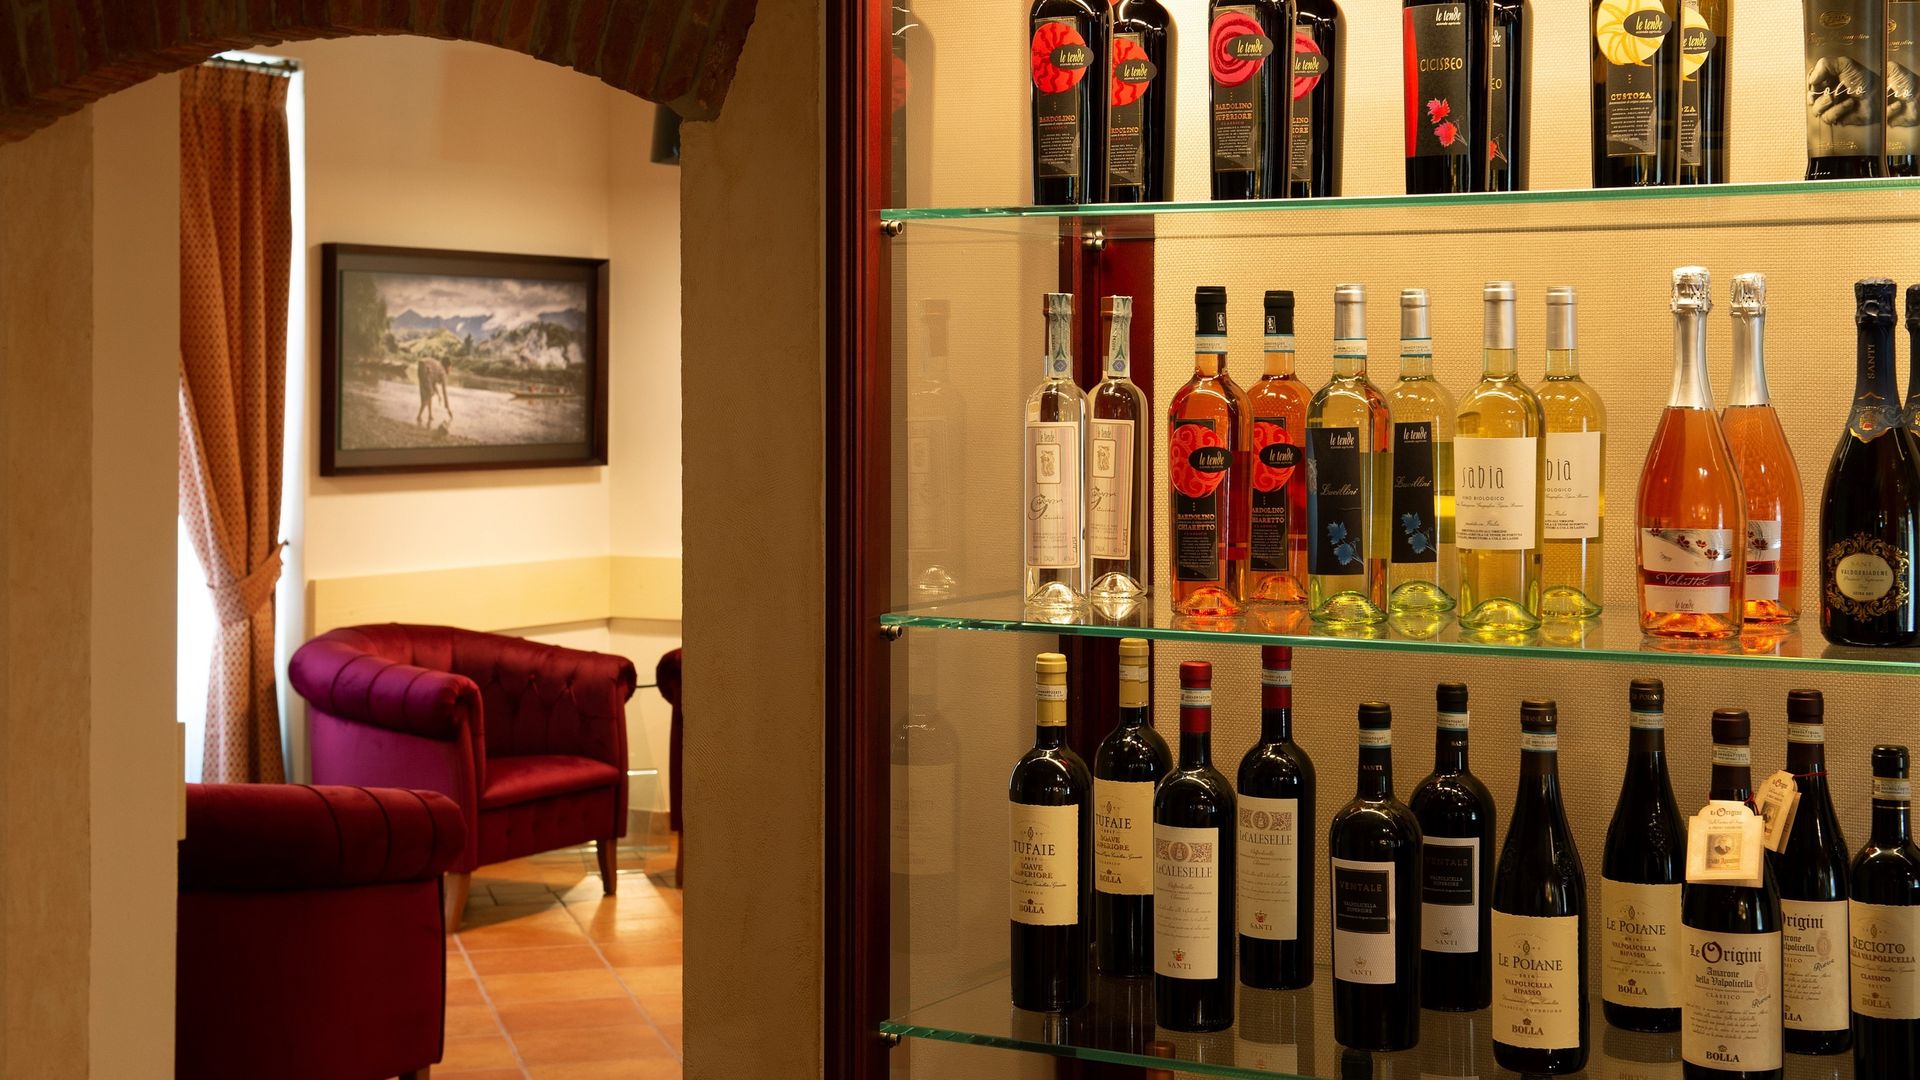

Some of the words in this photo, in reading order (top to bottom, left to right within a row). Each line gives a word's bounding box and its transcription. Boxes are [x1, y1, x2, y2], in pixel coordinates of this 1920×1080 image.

[1436, 8, 1442, 21] le
[1444, 6, 1461, 21] tende
[1636, 16, 1644, 30] le
[1644, 14, 1663, 30] tende
[1237, 40, 1244, 54] le
[1245, 38, 1263, 52] tende
[1688, 32, 1707, 46] tende
[1060, 50, 1066, 62] le
[1068, 48, 1084, 62] tende
[1124, 64, 1129, 77] le
[1130, 63, 1148, 76] tende
[1295, 57, 1302, 70] le
[1302, 56, 1320, 70] tende
[1420, 58, 1462, 72] CICISBEO
[1610, 92, 1652, 101] CUSTOZA
[1330, 433, 1336, 446] le
[1337, 432, 1354, 446] tende
[1404, 428, 1410, 440] le
[1410, 426, 1428, 440] tende
[1200, 454, 1206, 466] le
[1207, 452, 1224, 466] tende
[1270, 451, 1276, 462] le
[1276, 450, 1294, 462] tende
[1096, 814, 1132, 830] TUFAIE
[1014, 840, 1056, 856] TUFAIE
[1250, 923, 1272, 931] SANTI
[1619, 920, 1666, 936] POIANE
[1853, 936, 1906, 954] RECIOTO
[1702, 942, 1762, 966] Origini
[1862, 953, 1916, 964] VALPOLICELLA
[1513, 956, 1563, 972] POIANE
[1706, 966, 1740, 978] Amarone
[1860, 973, 1892, 982] CLASSICO
[1504, 978, 1552, 988] VALPOLICELLA
[1618, 984, 1648, 996] BOLLA
[1712, 978, 1753, 988] Valpolicella
[1514, 988, 1542, 996] RIPASSO
[1862, 998, 1892, 1008] BOLLA
[1784, 1012, 1802, 1022] LLA
[1512, 1024, 1544, 1036] BOLLA
[1706, 1051, 1740, 1062] BOLLA
